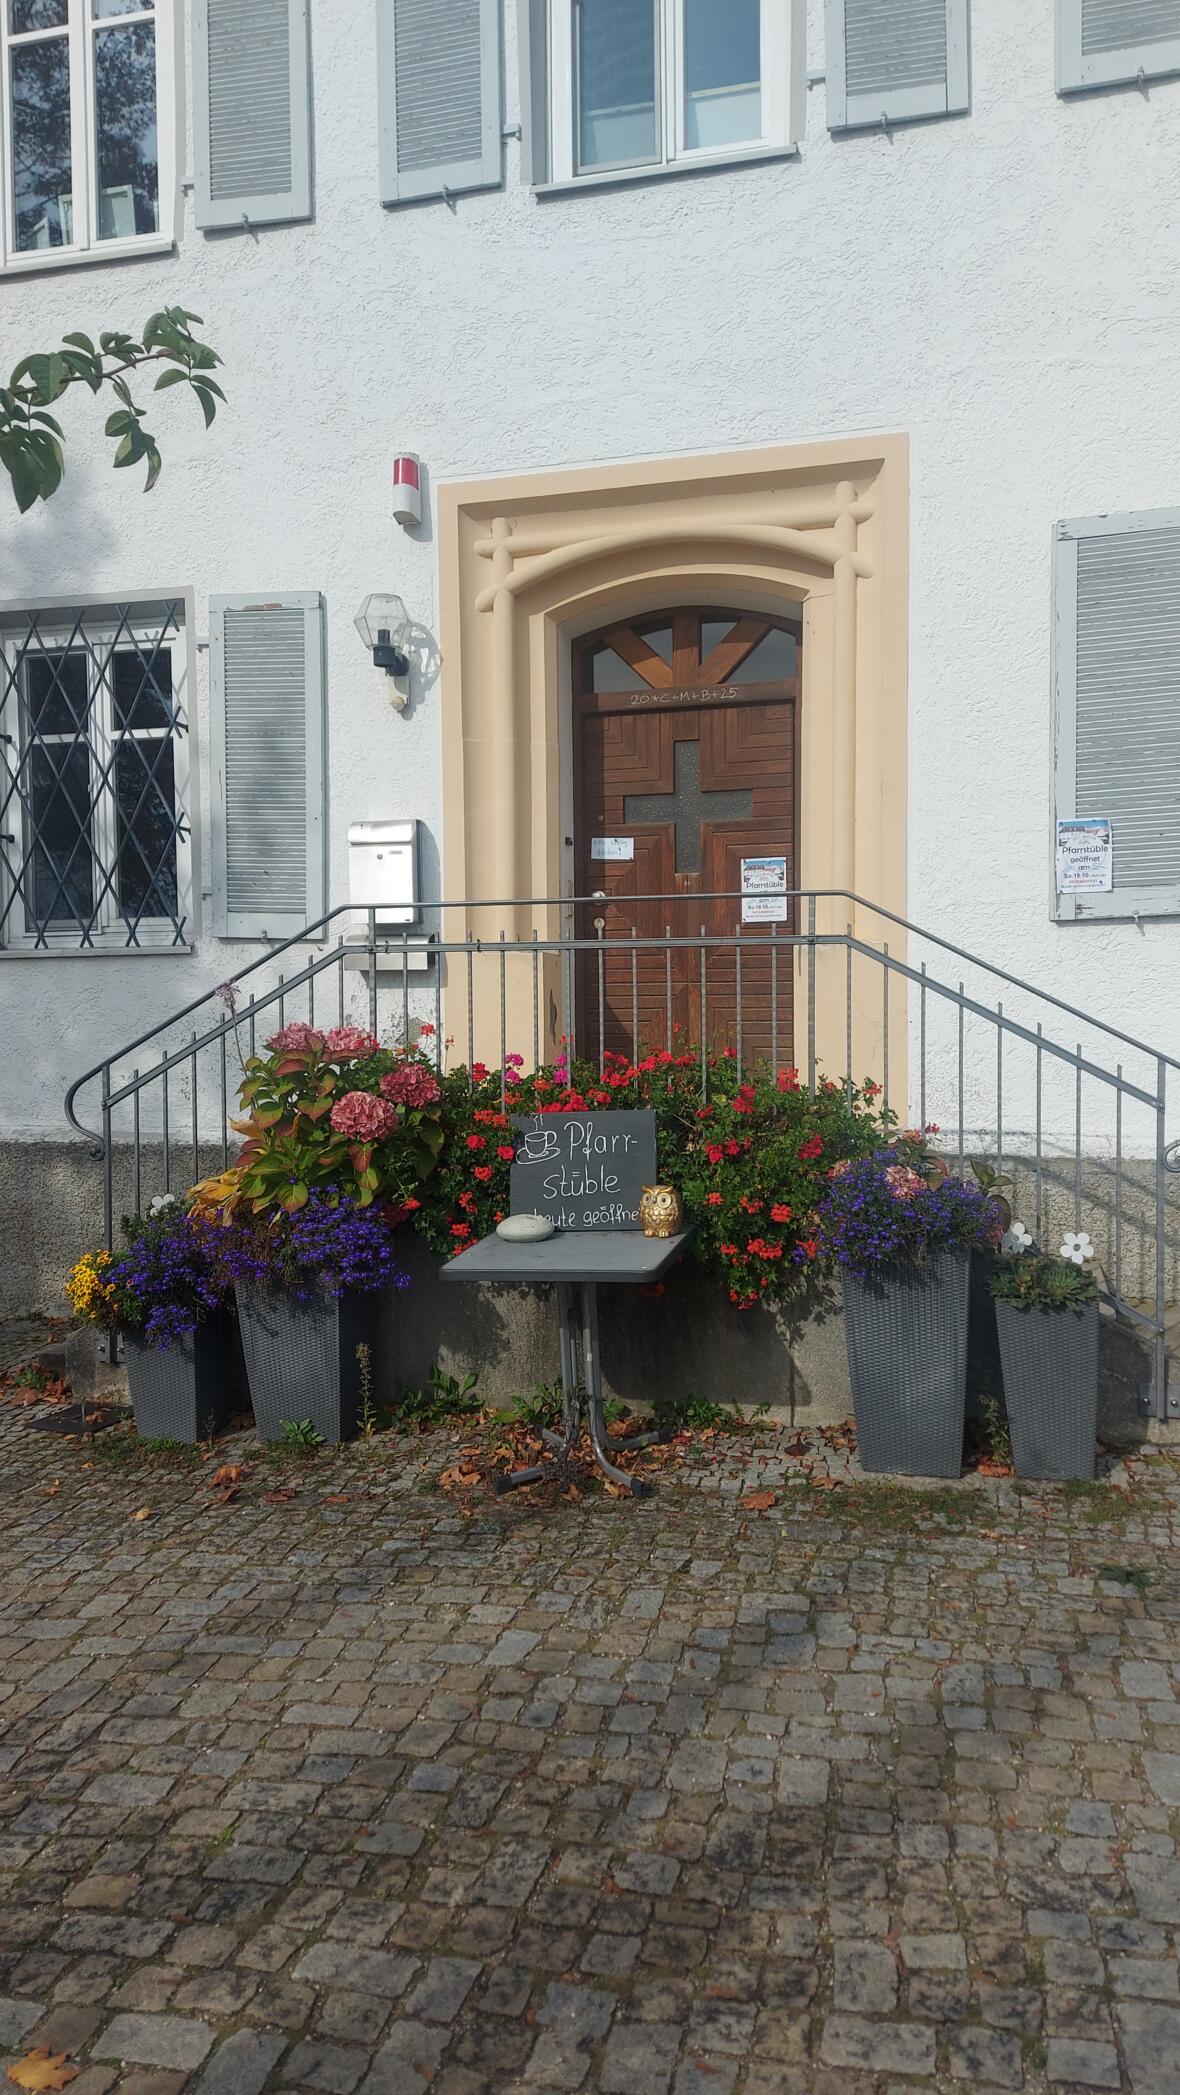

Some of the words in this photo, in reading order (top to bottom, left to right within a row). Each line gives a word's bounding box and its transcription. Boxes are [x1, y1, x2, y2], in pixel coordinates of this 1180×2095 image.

[1062, 845, 1109, 854] Pfarrstüble
[563, 1121, 639, 1161] Pfarr-
[583, 1204, 640, 1227] geöffne
